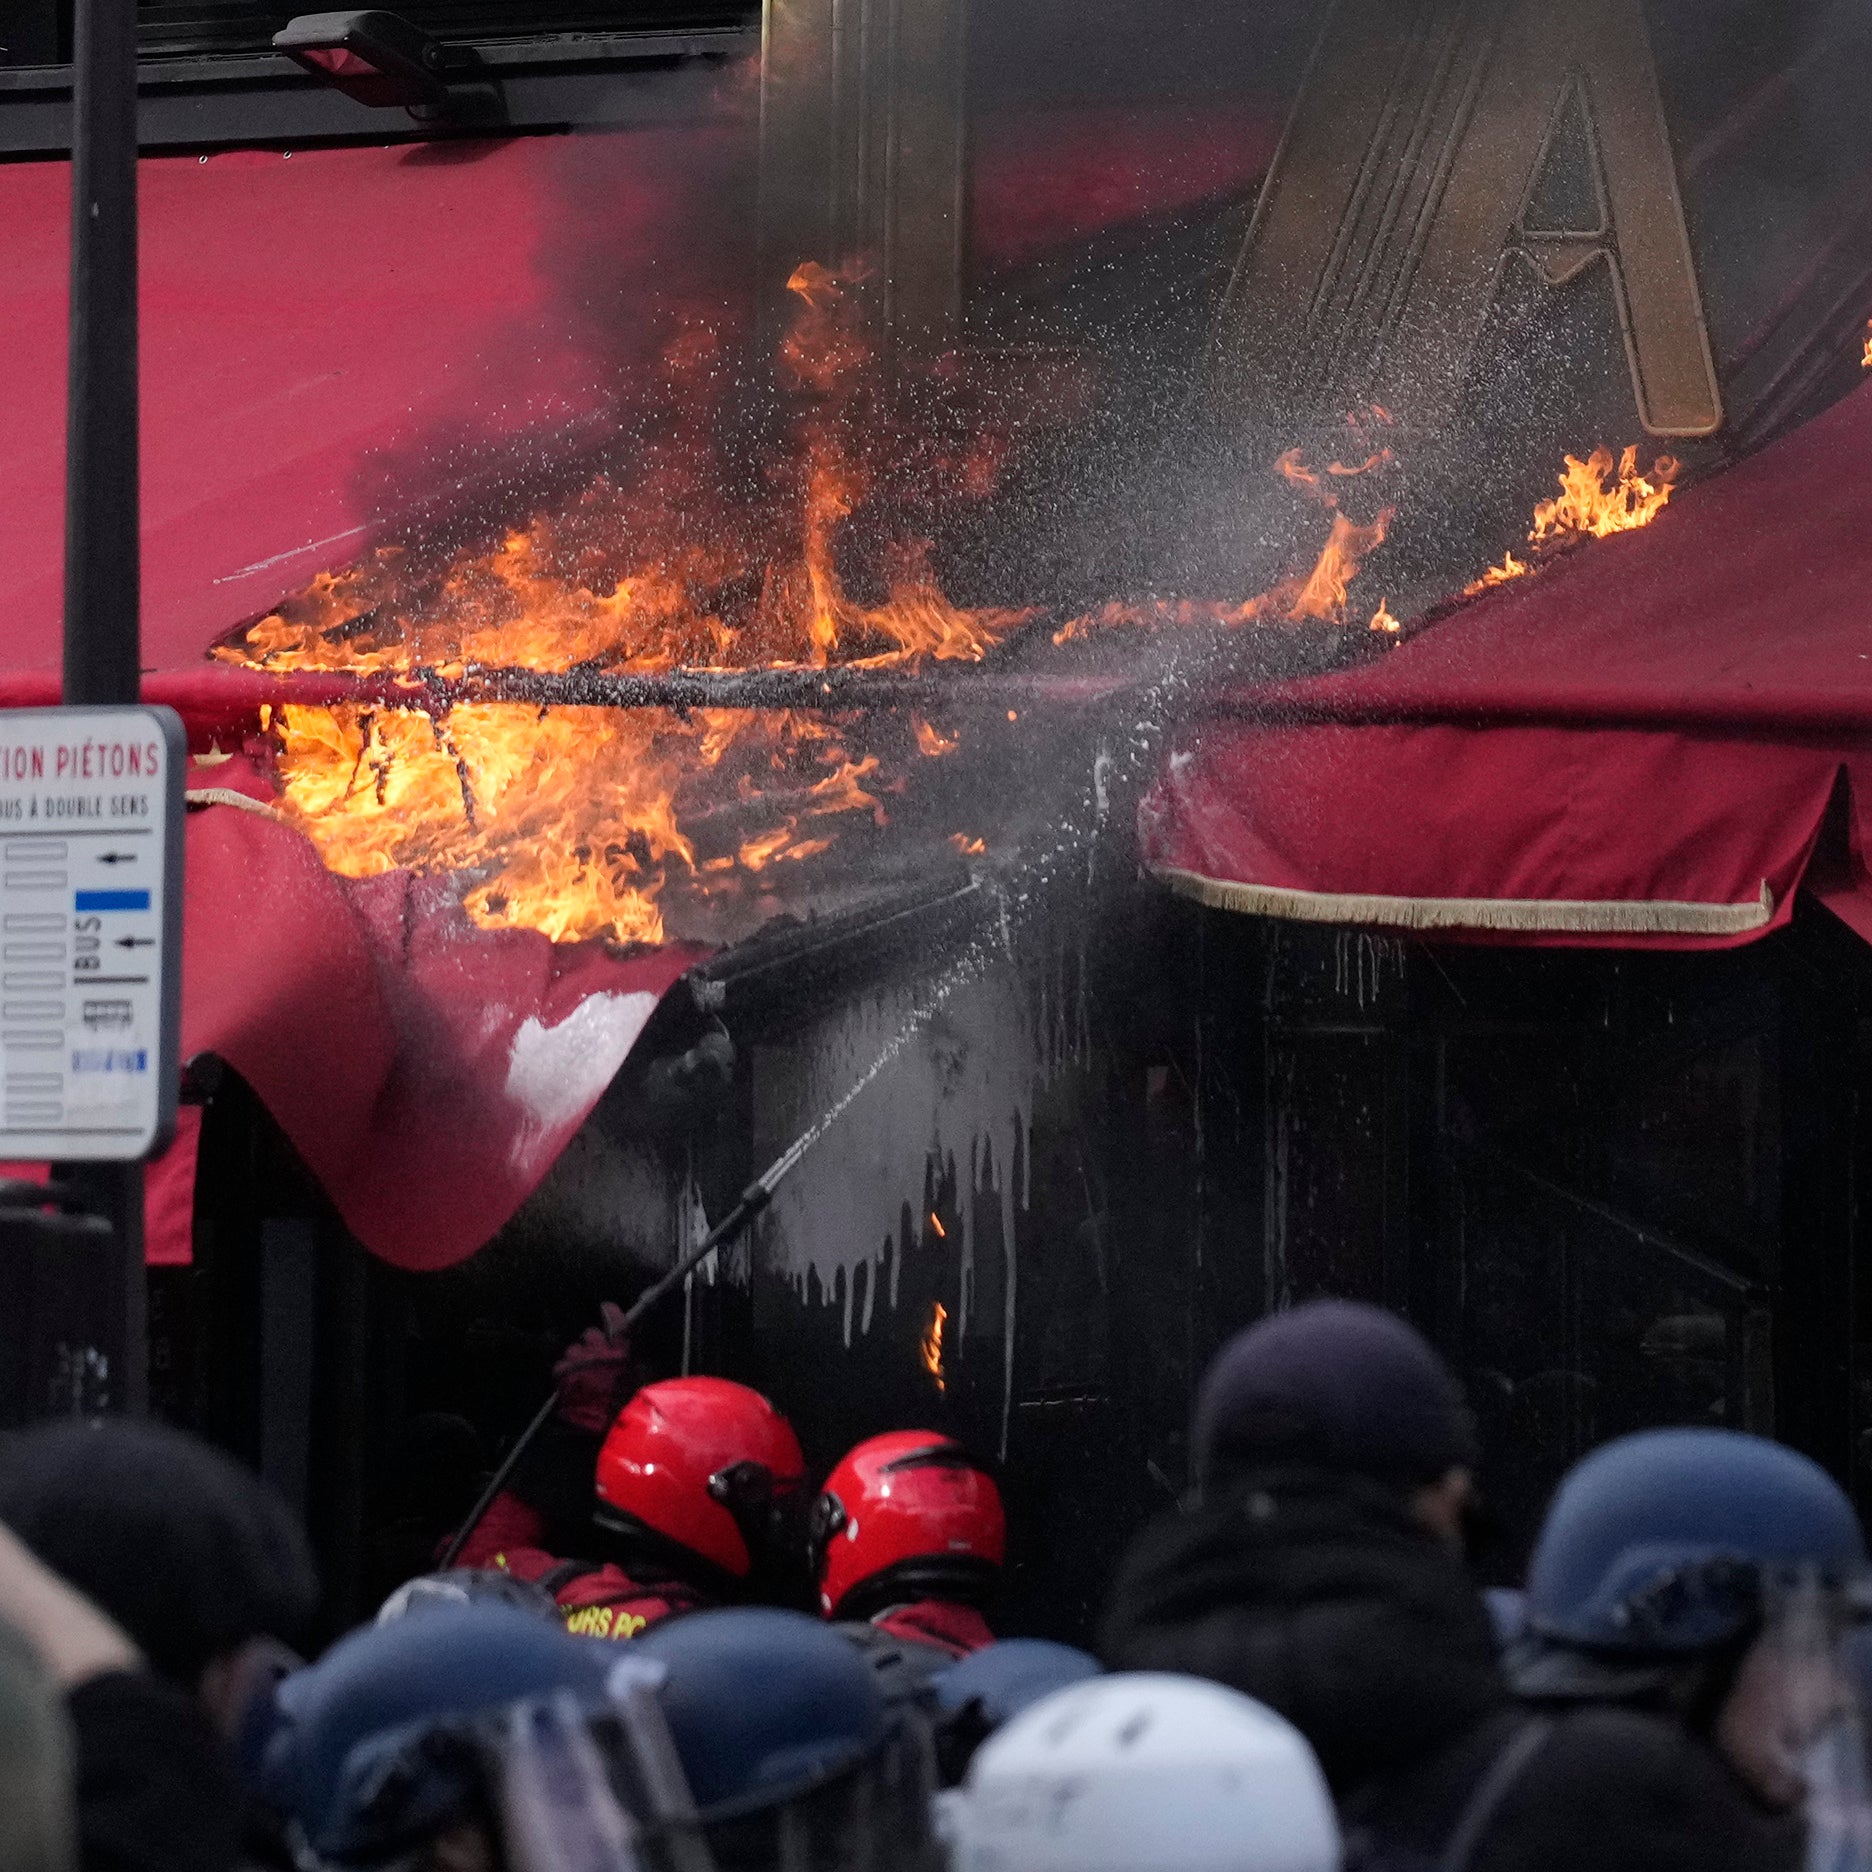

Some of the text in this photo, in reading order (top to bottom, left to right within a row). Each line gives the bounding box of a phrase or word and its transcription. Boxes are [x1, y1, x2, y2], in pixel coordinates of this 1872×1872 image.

[56, 736, 159, 778] PIÉTONS
[46, 795, 103, 818] DOUBLE
[111, 793, 149, 817] SENS
[74, 917, 102, 969] BUS
